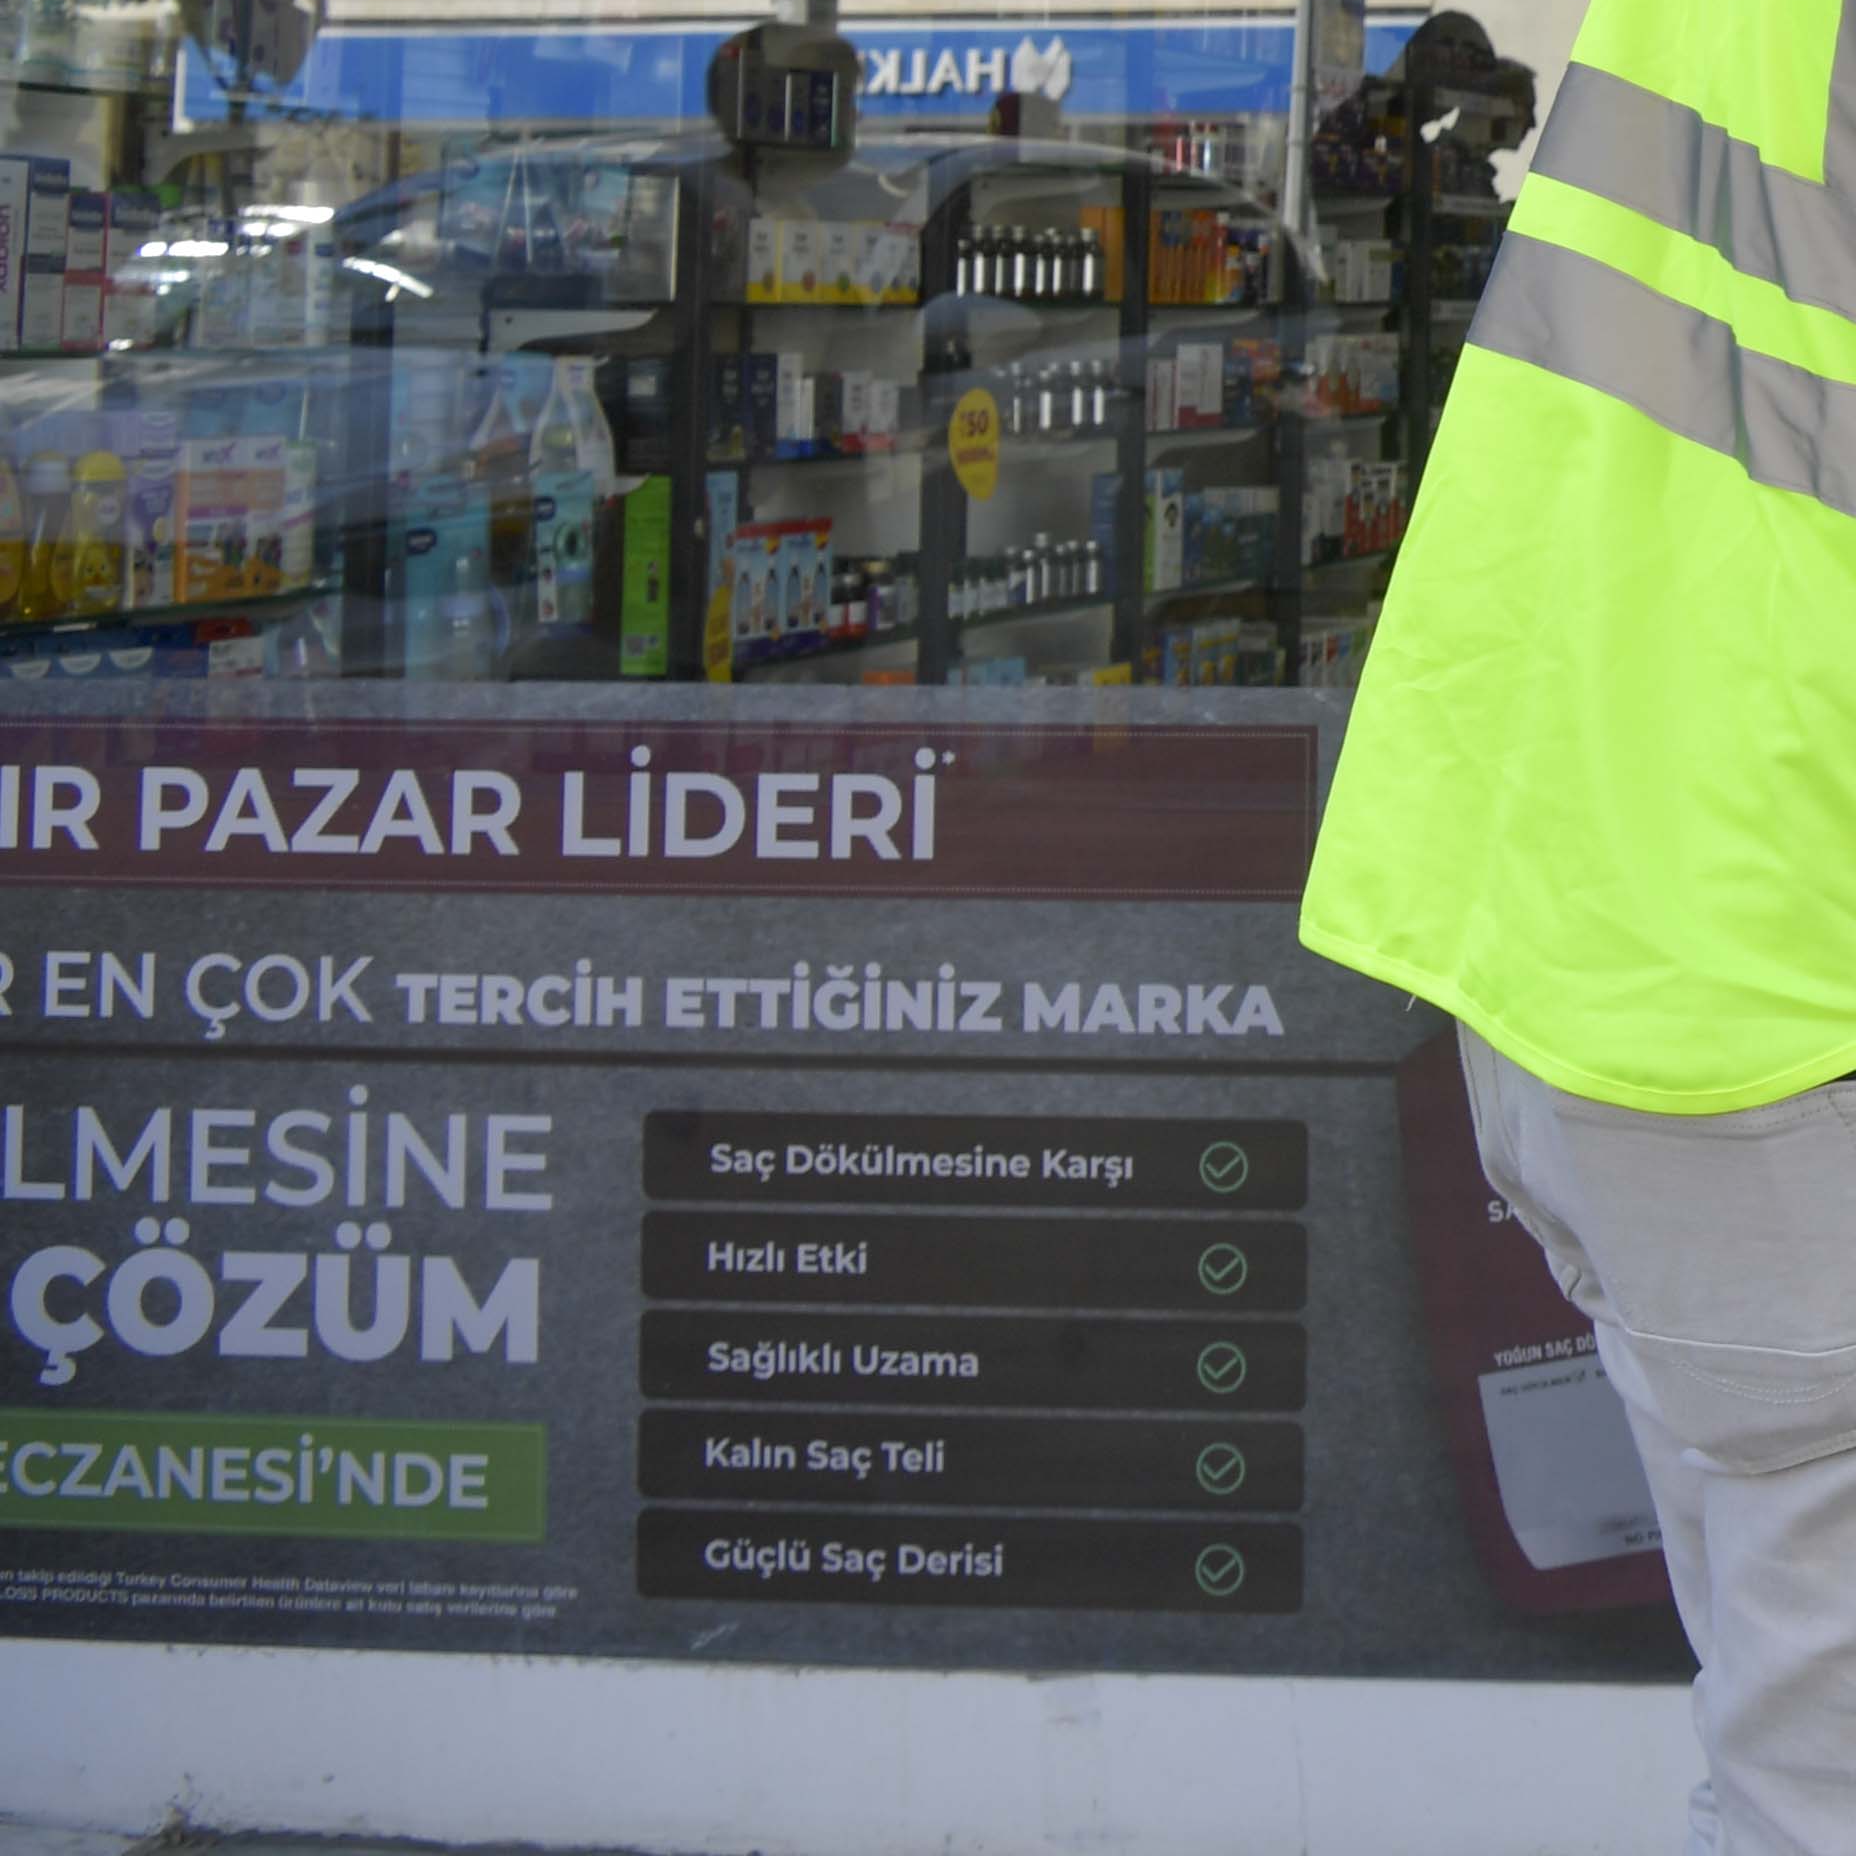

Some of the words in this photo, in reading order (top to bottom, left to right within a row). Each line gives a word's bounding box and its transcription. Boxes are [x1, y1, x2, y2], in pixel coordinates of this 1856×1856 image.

[139, 766, 519, 857] PAZAR
[43, 951, 156, 1019] EN
[185, 952, 374, 1040] ÇOK
[396, 960, 642, 1028] TERCİH
[665, 961, 1004, 1035] ETTİĞİNİZ
[1022, 982, 1284, 1038] MARKA
[2, 1085, 554, 1212] LMESİNE
[710, 1145, 776, 1185] Saç
[788, 1144, 1031, 1182] Dökülmesine
[1041, 1147, 1135, 1186] Karşı
[707, 1241, 786, 1276] Hızlı
[796, 1242, 867, 1277] Etki
[10, 1218, 540, 1385] ÇÖZÜM
[707, 1341, 843, 1382] Sağlıklı
[852, 1346, 980, 1379] Uzama
[1493, 1343, 1542, 1368] YOĞUN
[1545, 1338, 1573, 1358] SAÇ
[0, 1432, 489, 1509] CZANESİ'NDE
[704, 1437, 799, 1473] Kalın
[807, 1439, 874, 1480] Saç
[883, 1440, 945, 1475] Teli
[704, 1539, 813, 1580] Güçlü
[821, 1541, 890, 1581] Saç
[898, 1542, 1004, 1578] Derisi
[42, 1587, 129, 1604] PRODUCTS
